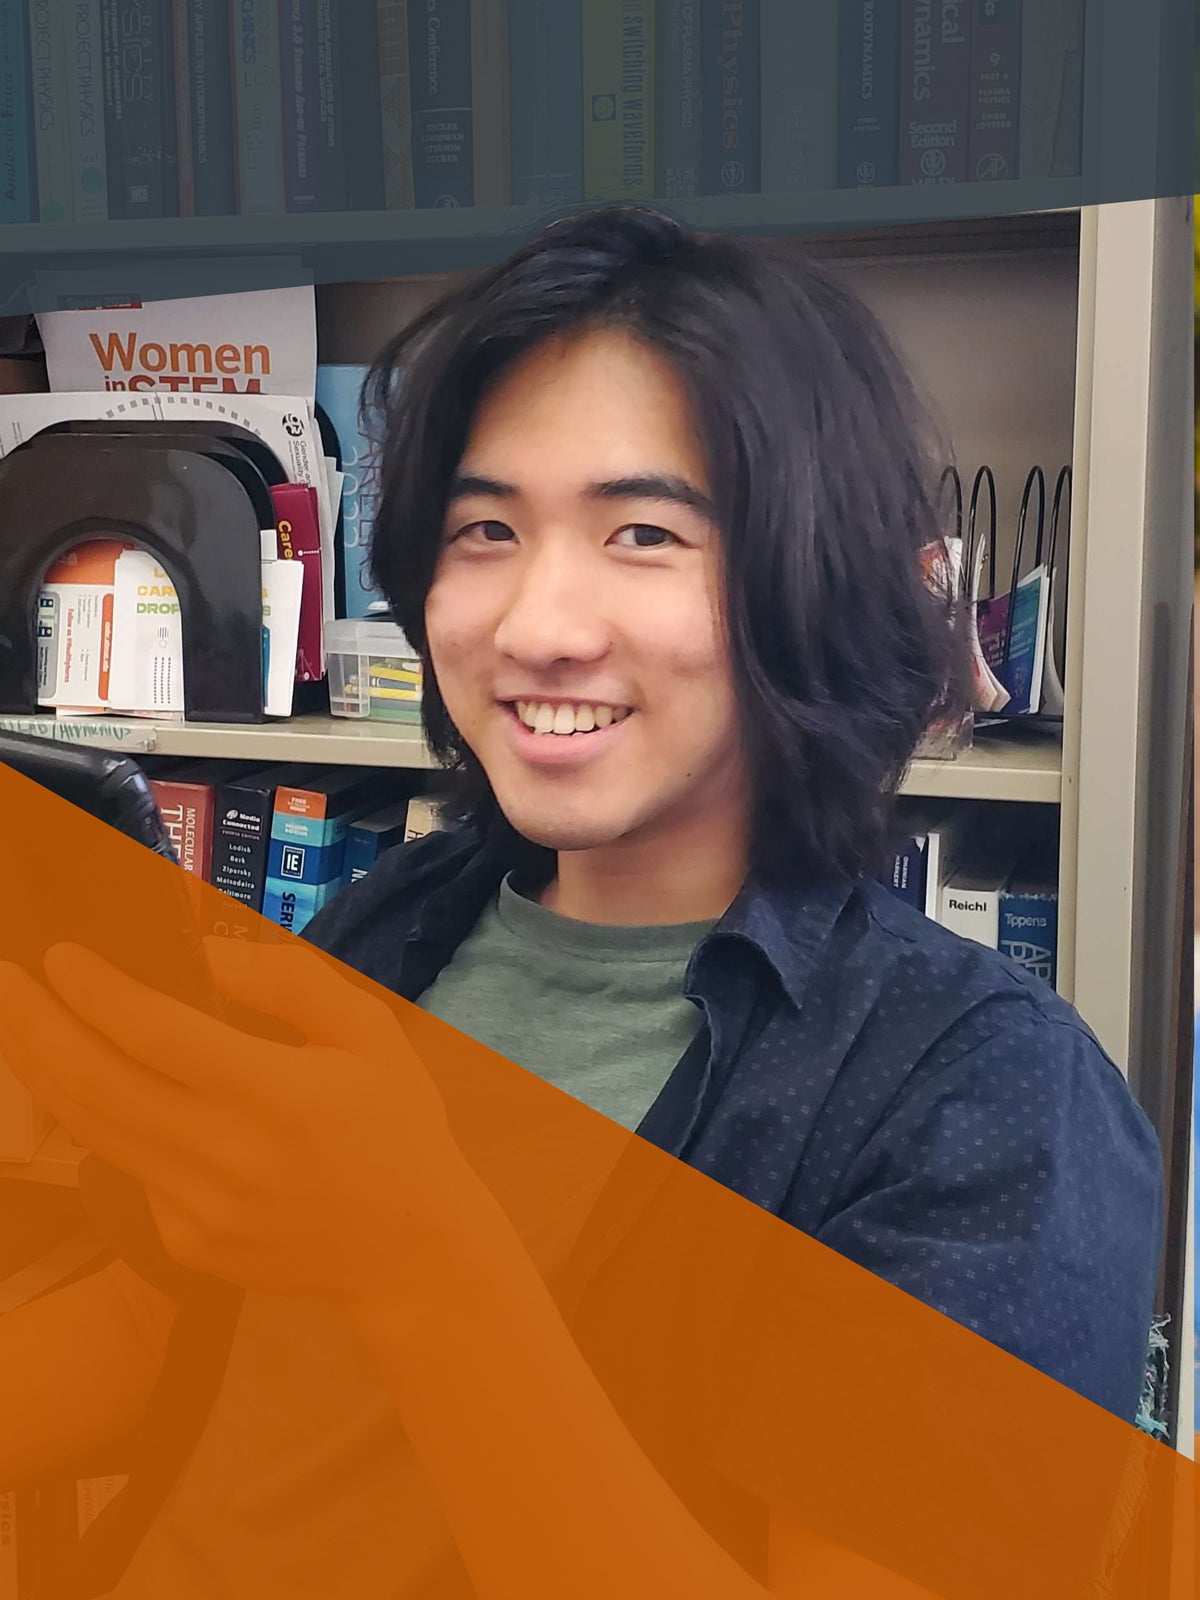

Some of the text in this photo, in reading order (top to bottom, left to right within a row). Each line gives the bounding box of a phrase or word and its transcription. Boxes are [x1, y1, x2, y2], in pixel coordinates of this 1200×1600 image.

[427, 16, 441, 95] Conference
[621, 15, 647, 94] switching
[75, 3, 95, 138] PROJECT PHYSICS
[718, 2, 745, 150] Physics
[38, 67, 55, 132] PHYSICS
[909, 120, 957, 135] Second
[910, 134, 955, 148] Edition
[622, 99, 647, 186] waveforms
[89, 332, 271, 375] Women
[105, 375, 126, 392] in
[278, 520, 295, 558] Care
[222, 819, 260, 832] Connected
[239, 812, 260, 823] Media
[184, 807, 197, 871] MOLECULAR
[229, 843, 252, 853] Lodish
[230, 855, 246, 864] Berk
[286, 853, 299, 871] IE
[948, 899, 987, 912] Reichl
